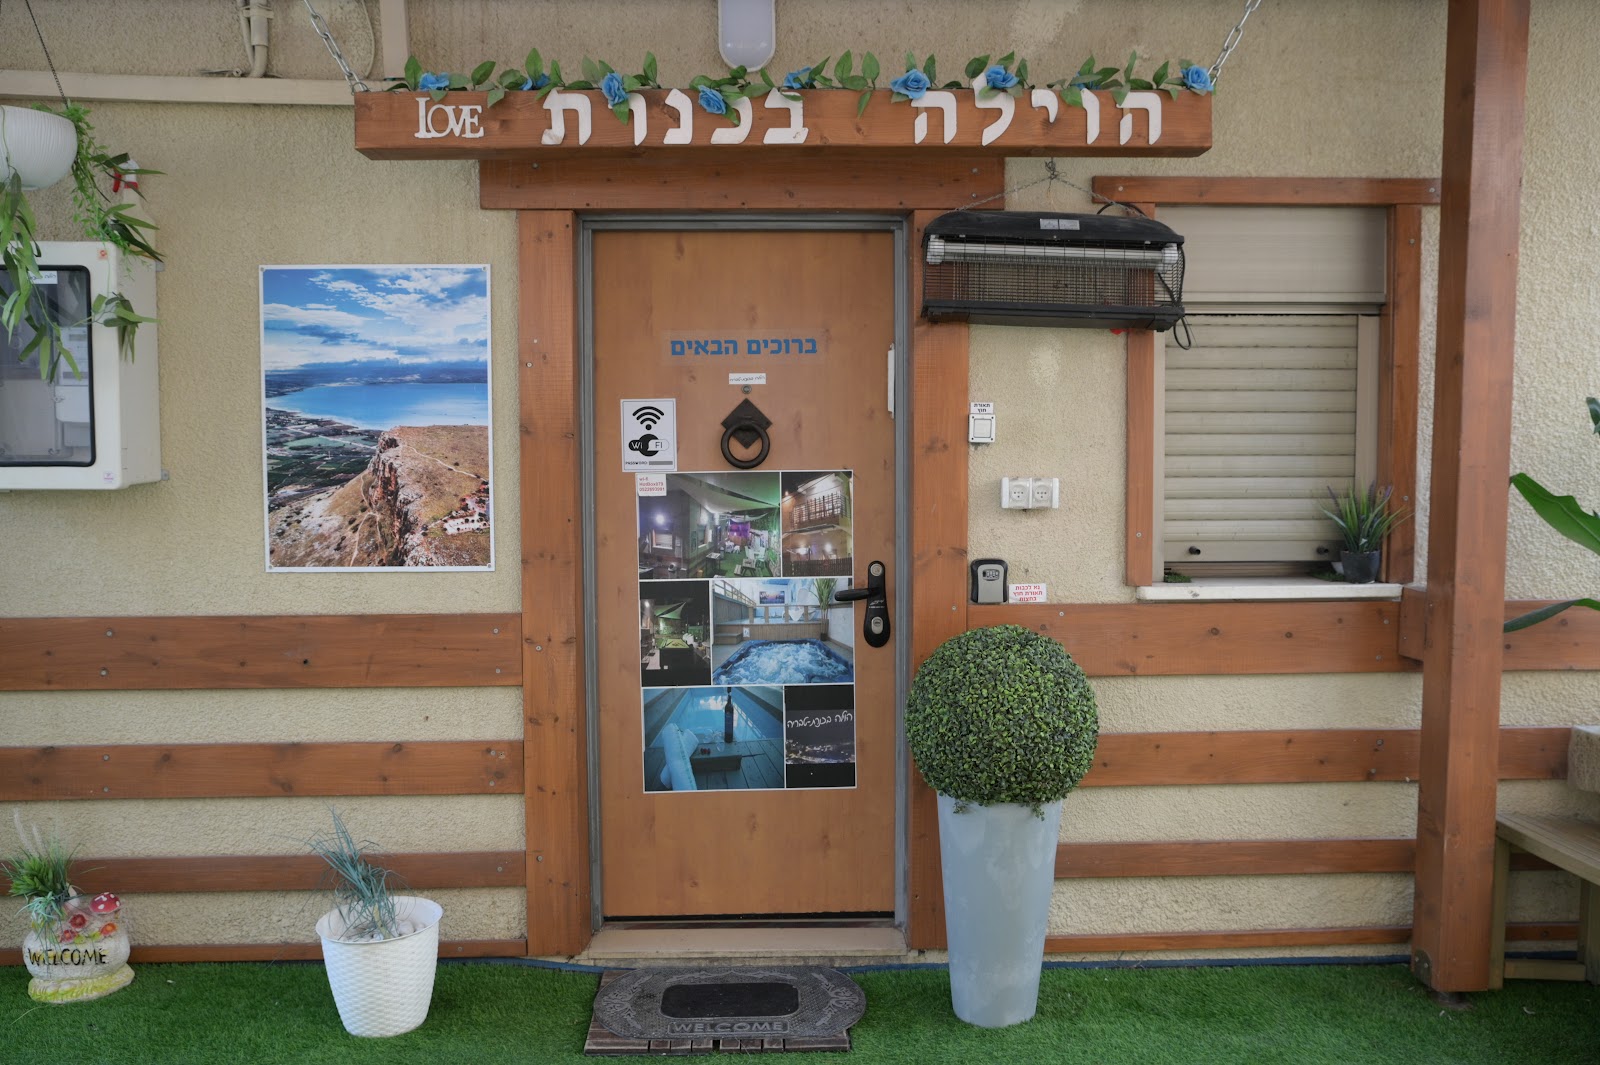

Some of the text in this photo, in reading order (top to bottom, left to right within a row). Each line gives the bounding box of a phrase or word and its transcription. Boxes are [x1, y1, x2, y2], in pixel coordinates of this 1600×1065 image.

[414, 97, 485, 138] LOVE
[541, 73, 1162, 146] הוילה בכנרת
[671, 337, 818, 356] ברוכים הבאים
[27, 947, 110, 967] WELCOME
[673, 1021, 783, 1032] WELCOME
